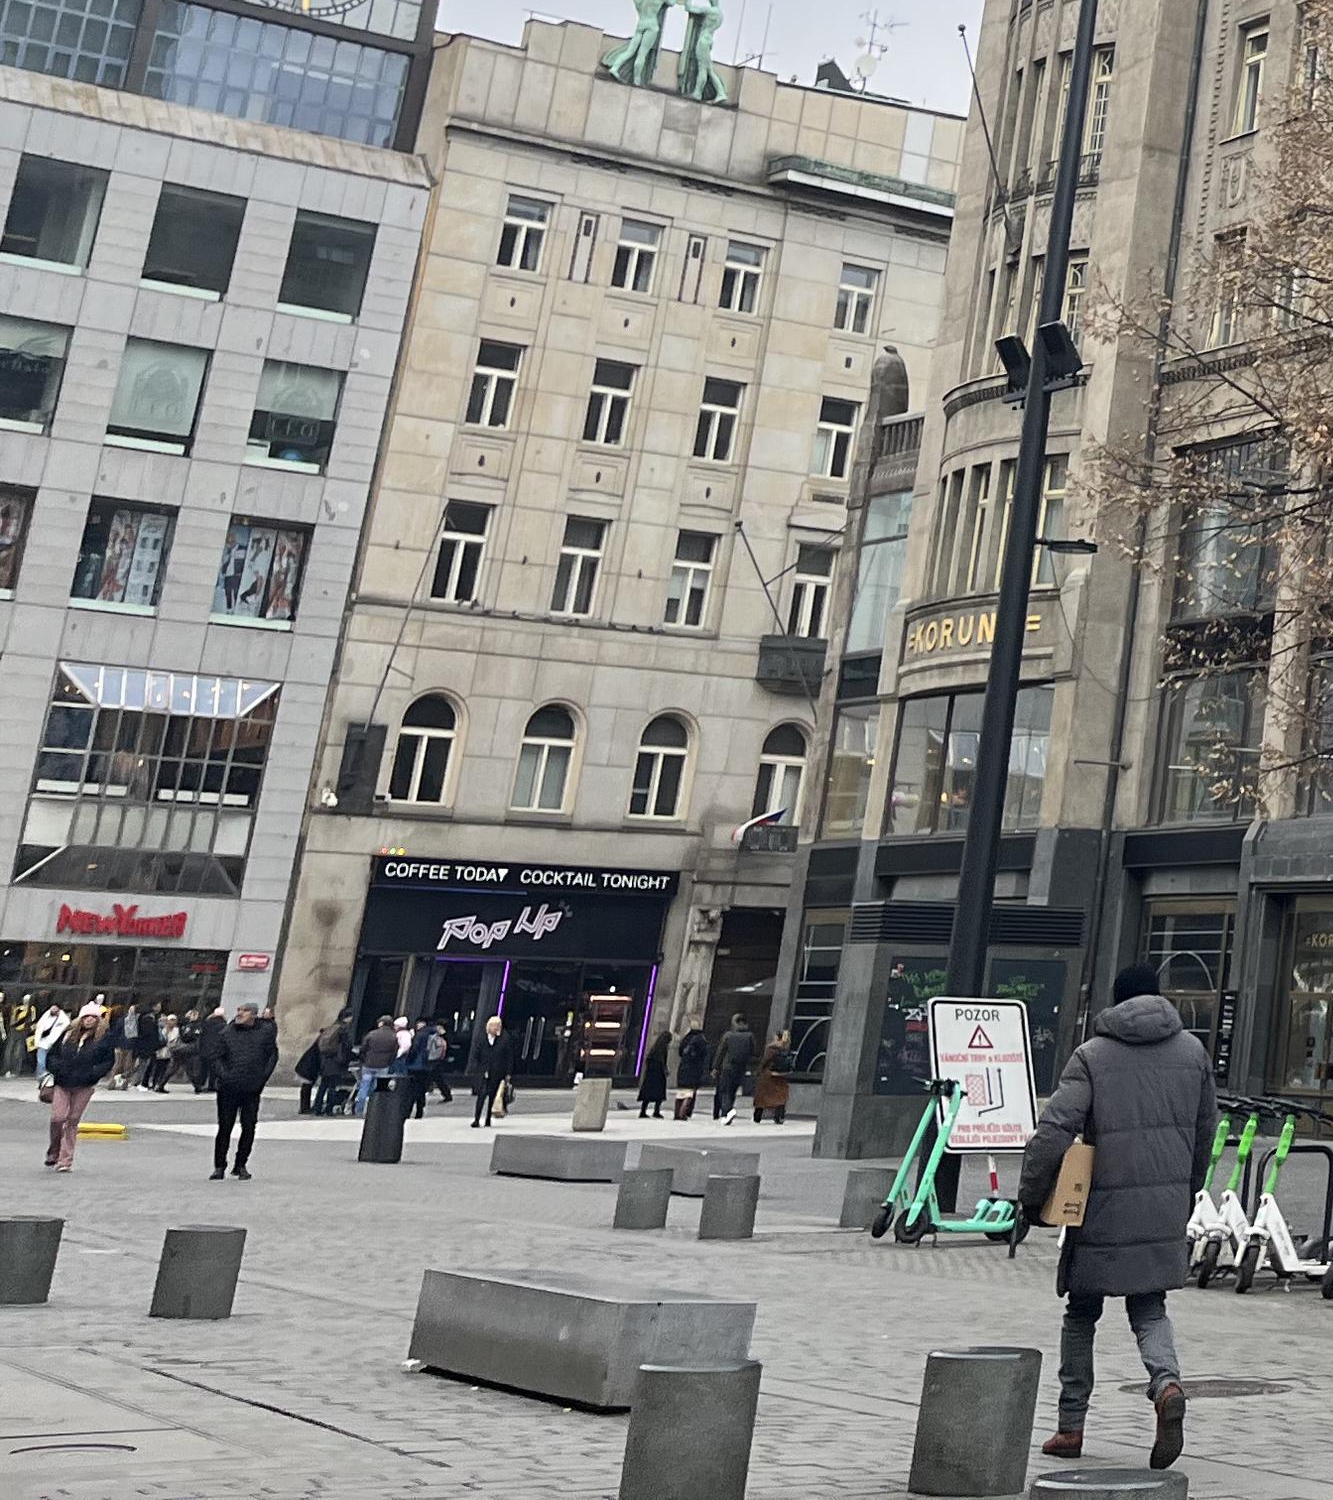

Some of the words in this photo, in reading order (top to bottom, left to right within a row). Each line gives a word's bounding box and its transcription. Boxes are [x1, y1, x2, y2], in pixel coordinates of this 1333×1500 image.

[913, 611, 997, 654] KORUN
[384, 861, 451, 881] COFFEE
[519, 868, 598, 888] COCKTAIL
[601, 872, 670, 891] TONIGHT
[955, 1008, 1000, 1021] POZOR
